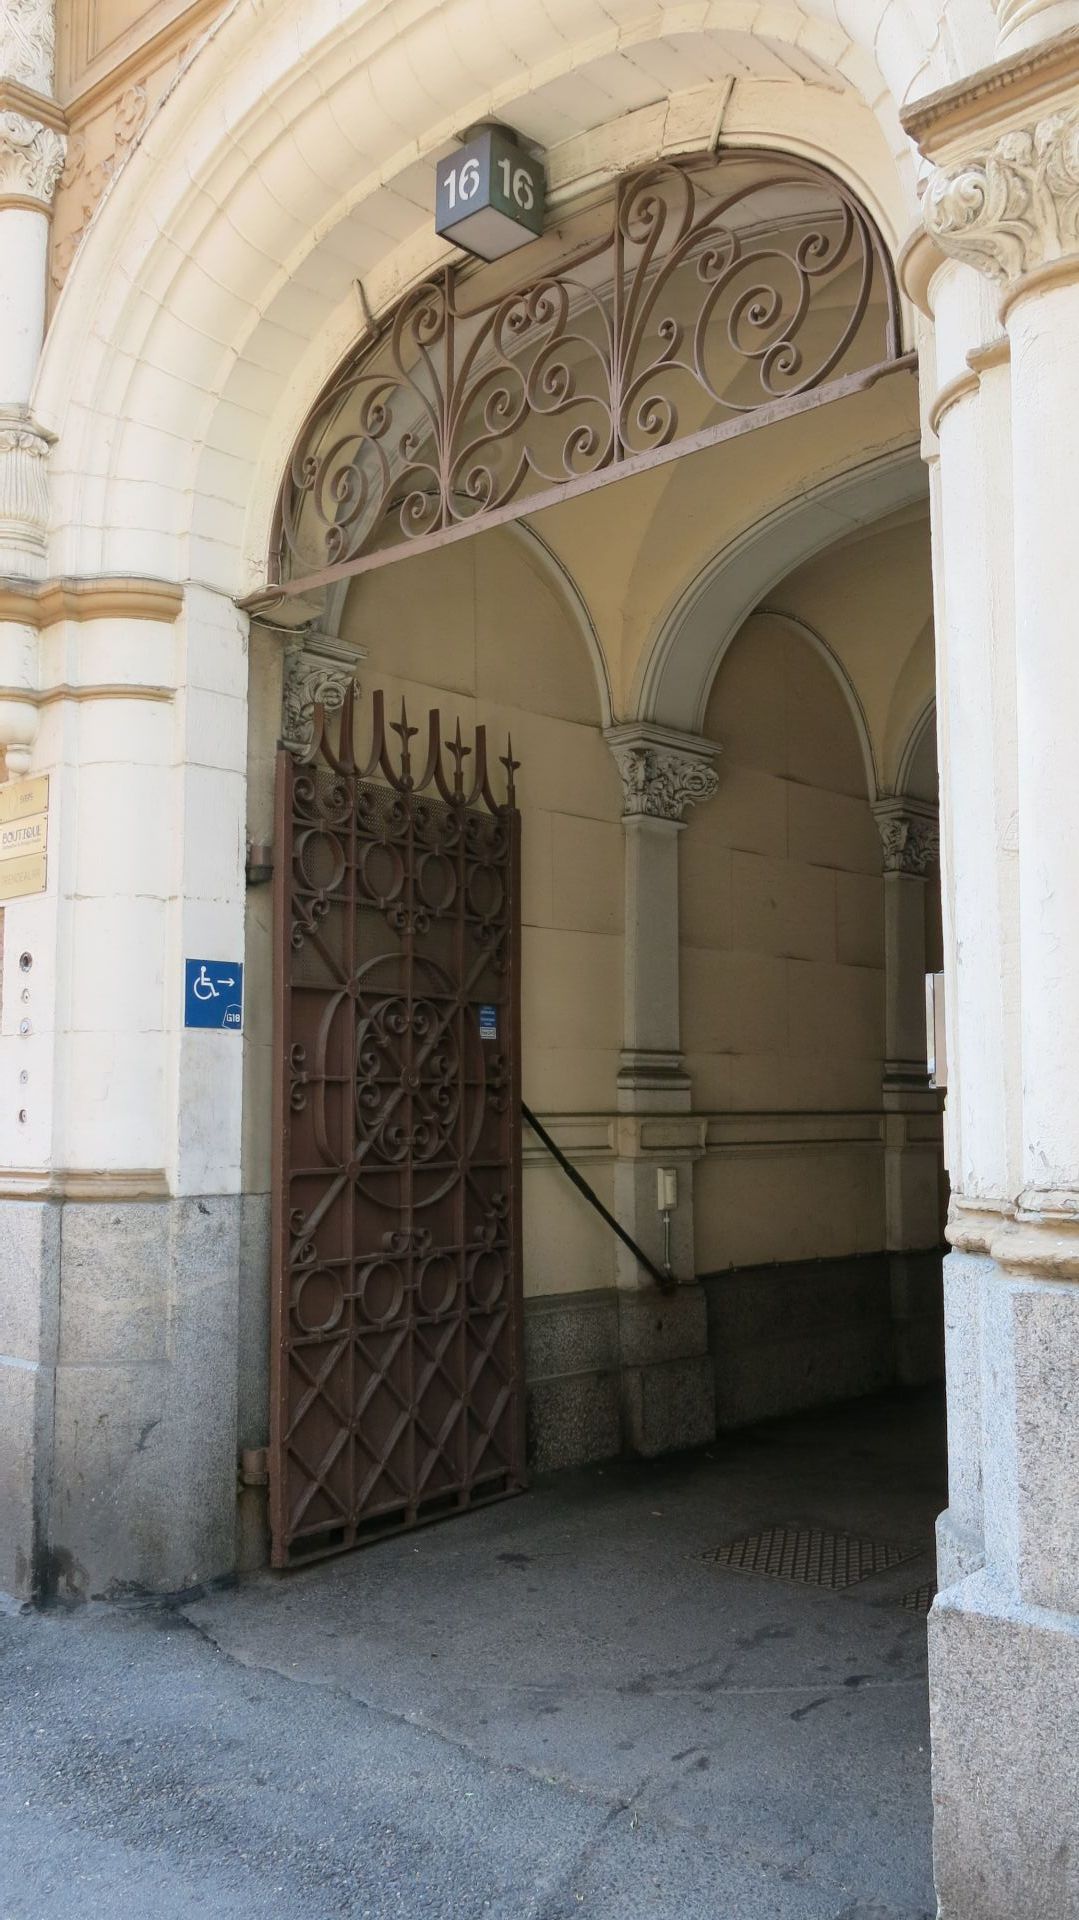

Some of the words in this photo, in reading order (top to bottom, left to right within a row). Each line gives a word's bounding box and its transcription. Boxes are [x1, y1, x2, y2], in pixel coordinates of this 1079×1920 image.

[443, 158, 480, 209] 16
[497, 158, 534, 210] 16
[226, 1013, 241, 1023] G18
